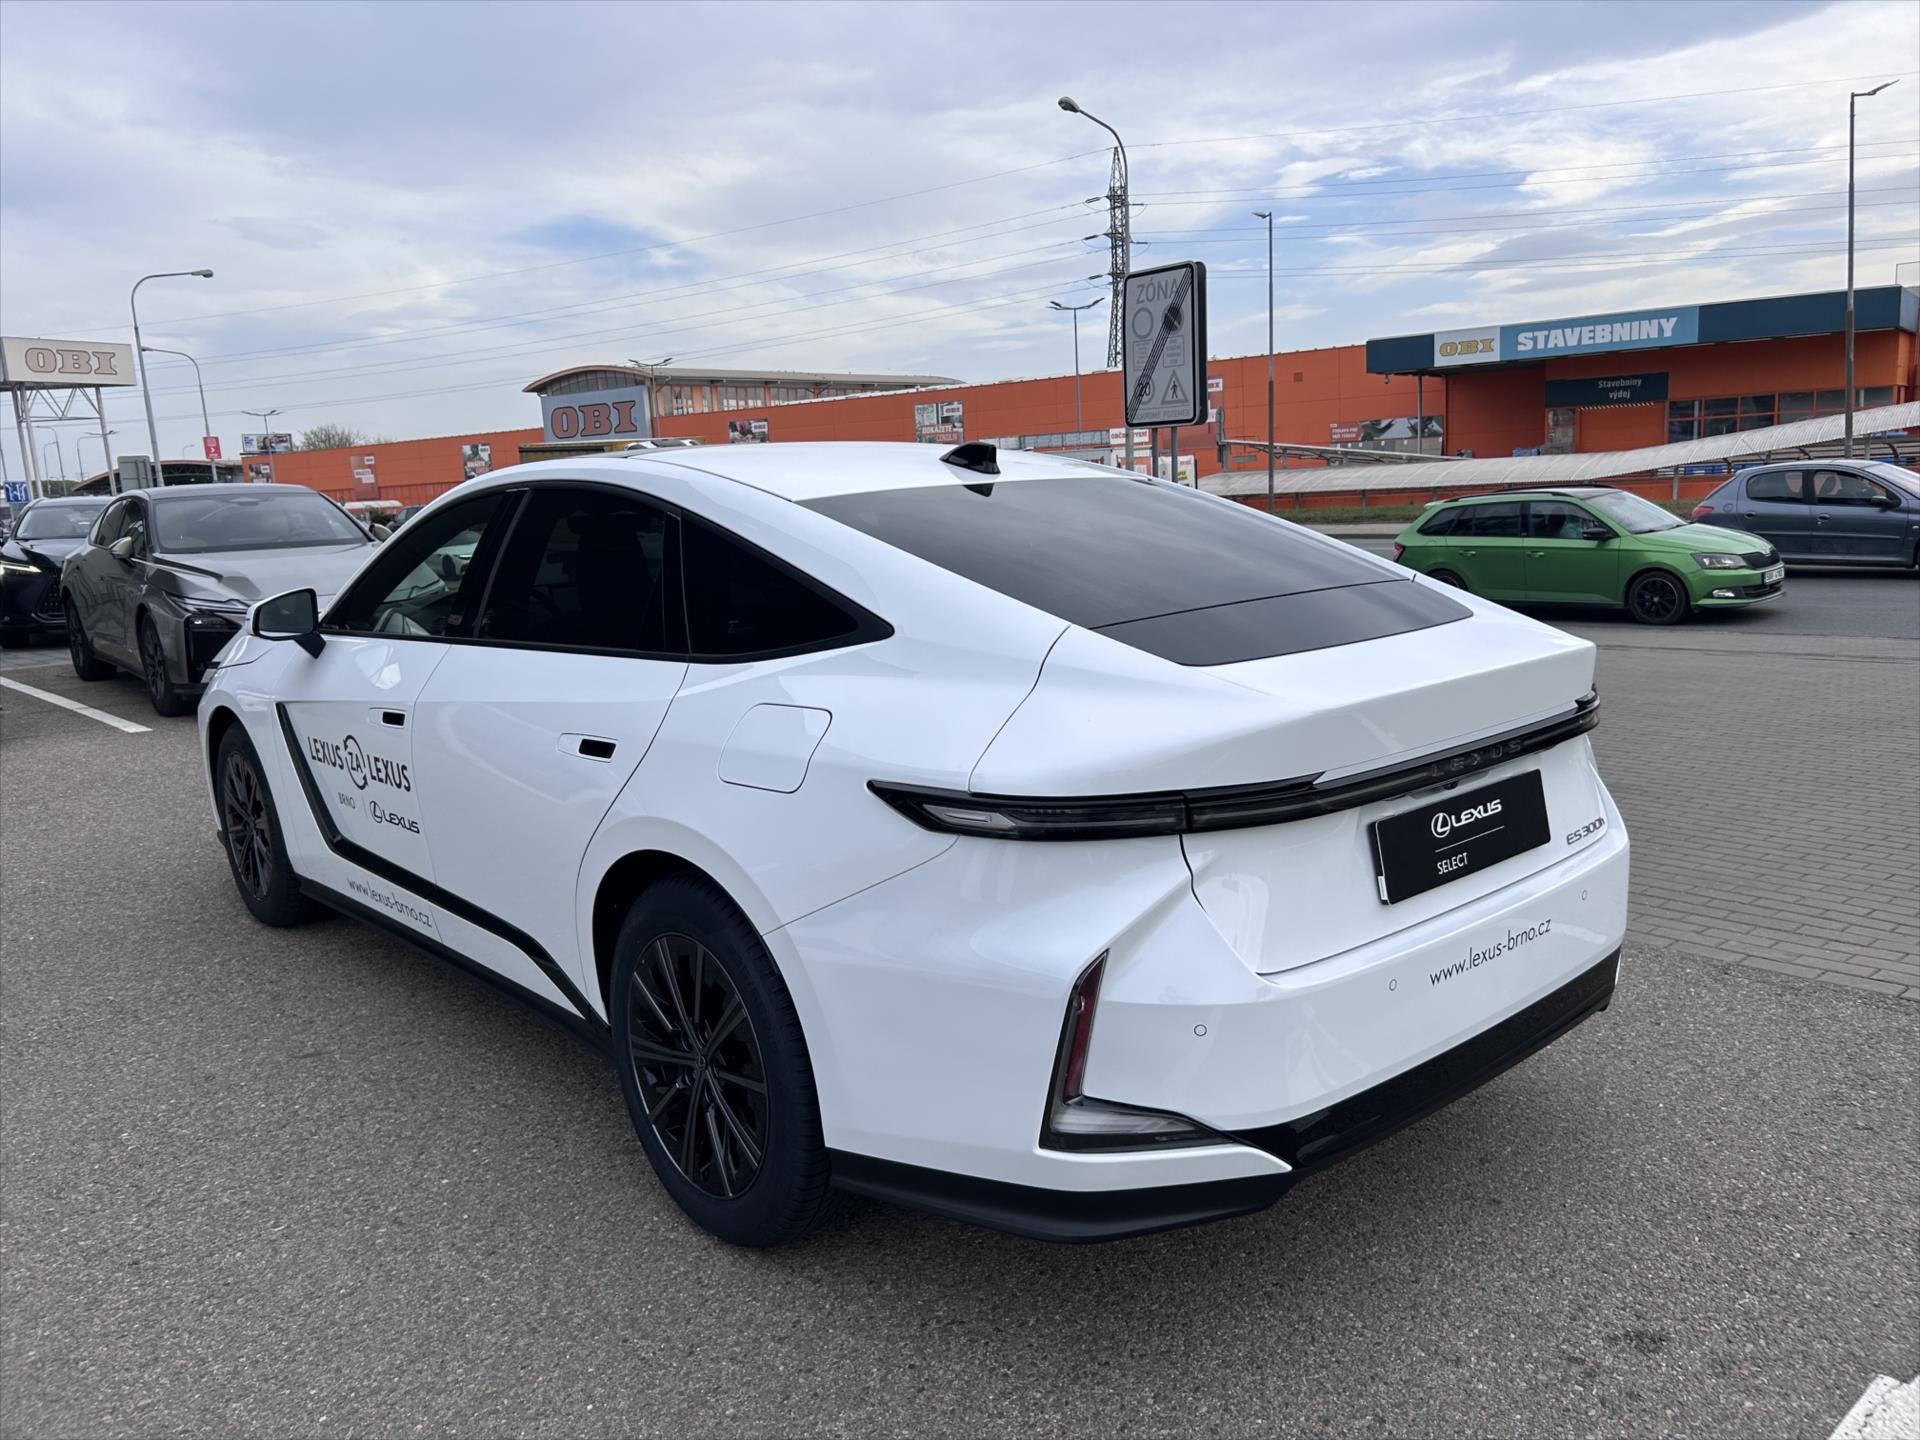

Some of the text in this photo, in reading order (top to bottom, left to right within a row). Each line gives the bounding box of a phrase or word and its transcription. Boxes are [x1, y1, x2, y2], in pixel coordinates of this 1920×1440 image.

[1136, 277, 1180, 304] ZÓNA
[1440, 317, 1678, 357] OBI STAVEBNINY
[24, 347, 117, 375] OBI
[1598, 378, 1643, 388] Stavebniny
[1609, 390, 1631, 400] výdej
[550, 400, 638, 438] OBI
[307, 735, 411, 792] LEXUS ZA LEXUS
[337, 792, 356, 809] BRNO
[1450, 799, 1503, 828] LEXUS
[382, 808, 420, 834] LEXUS
[1436, 852, 1469, 876] SELECT
[347, 878, 432, 928] www.lexus-brno.cz
[1429, 918, 1552, 986] www.lexus-brno.cz
